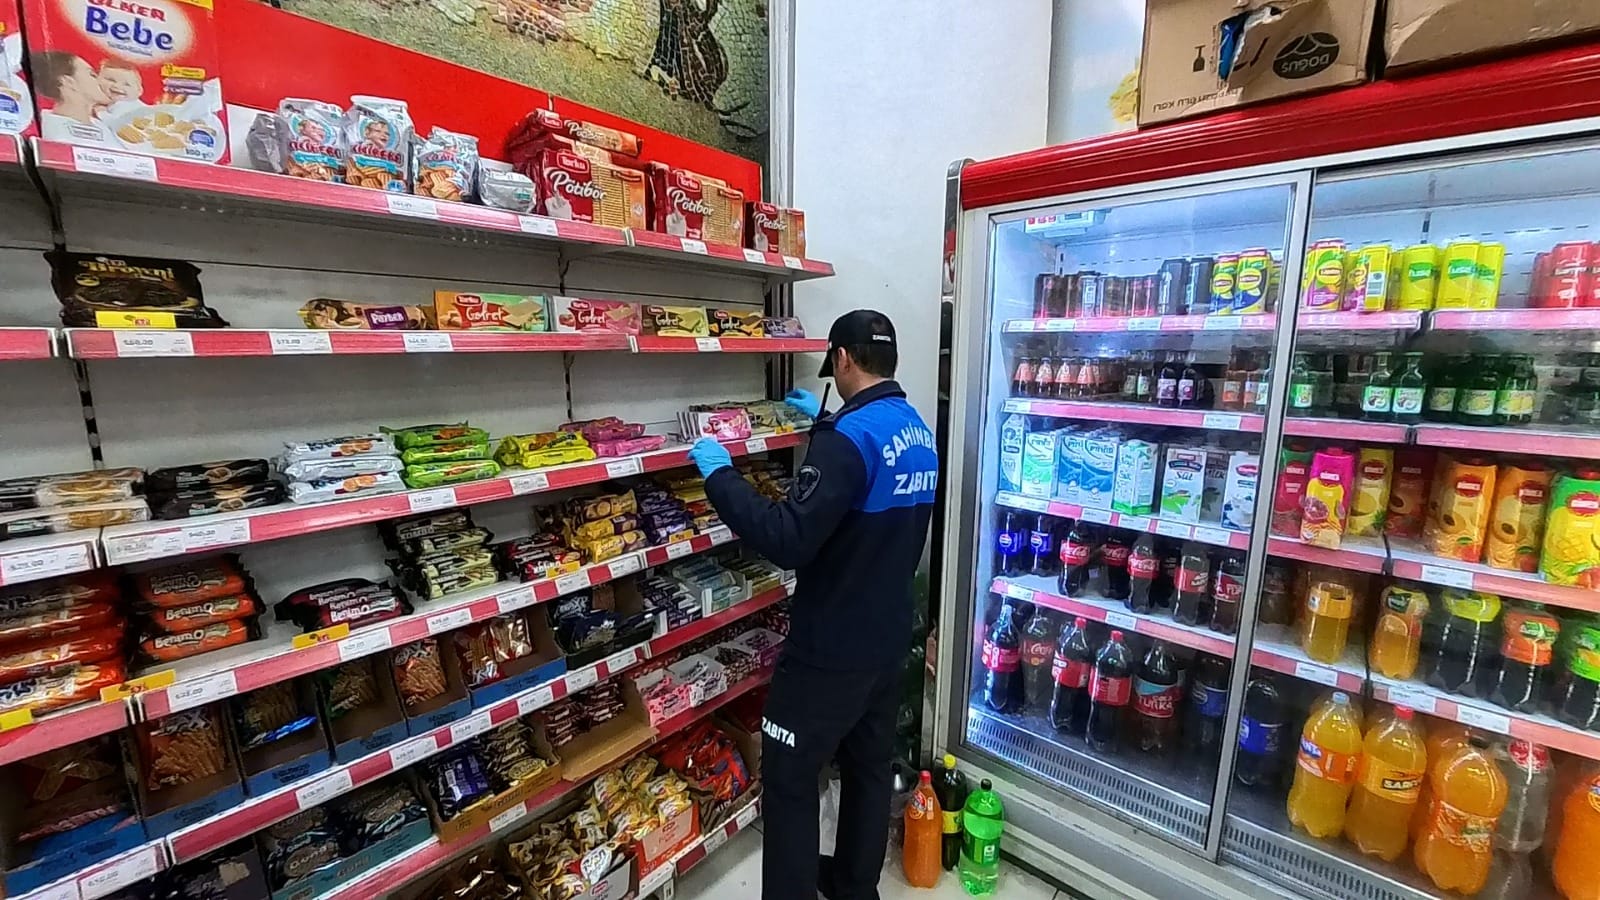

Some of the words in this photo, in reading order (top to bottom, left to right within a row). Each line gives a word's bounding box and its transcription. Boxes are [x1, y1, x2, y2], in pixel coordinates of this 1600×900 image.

[85, 5, 174, 51] Bebe
[561, 155, 586, 170] Torku
[680, 176, 699, 189] Torku
[893, 470, 937, 496] ZABIT
[761, 716, 796, 748] ZABITA
